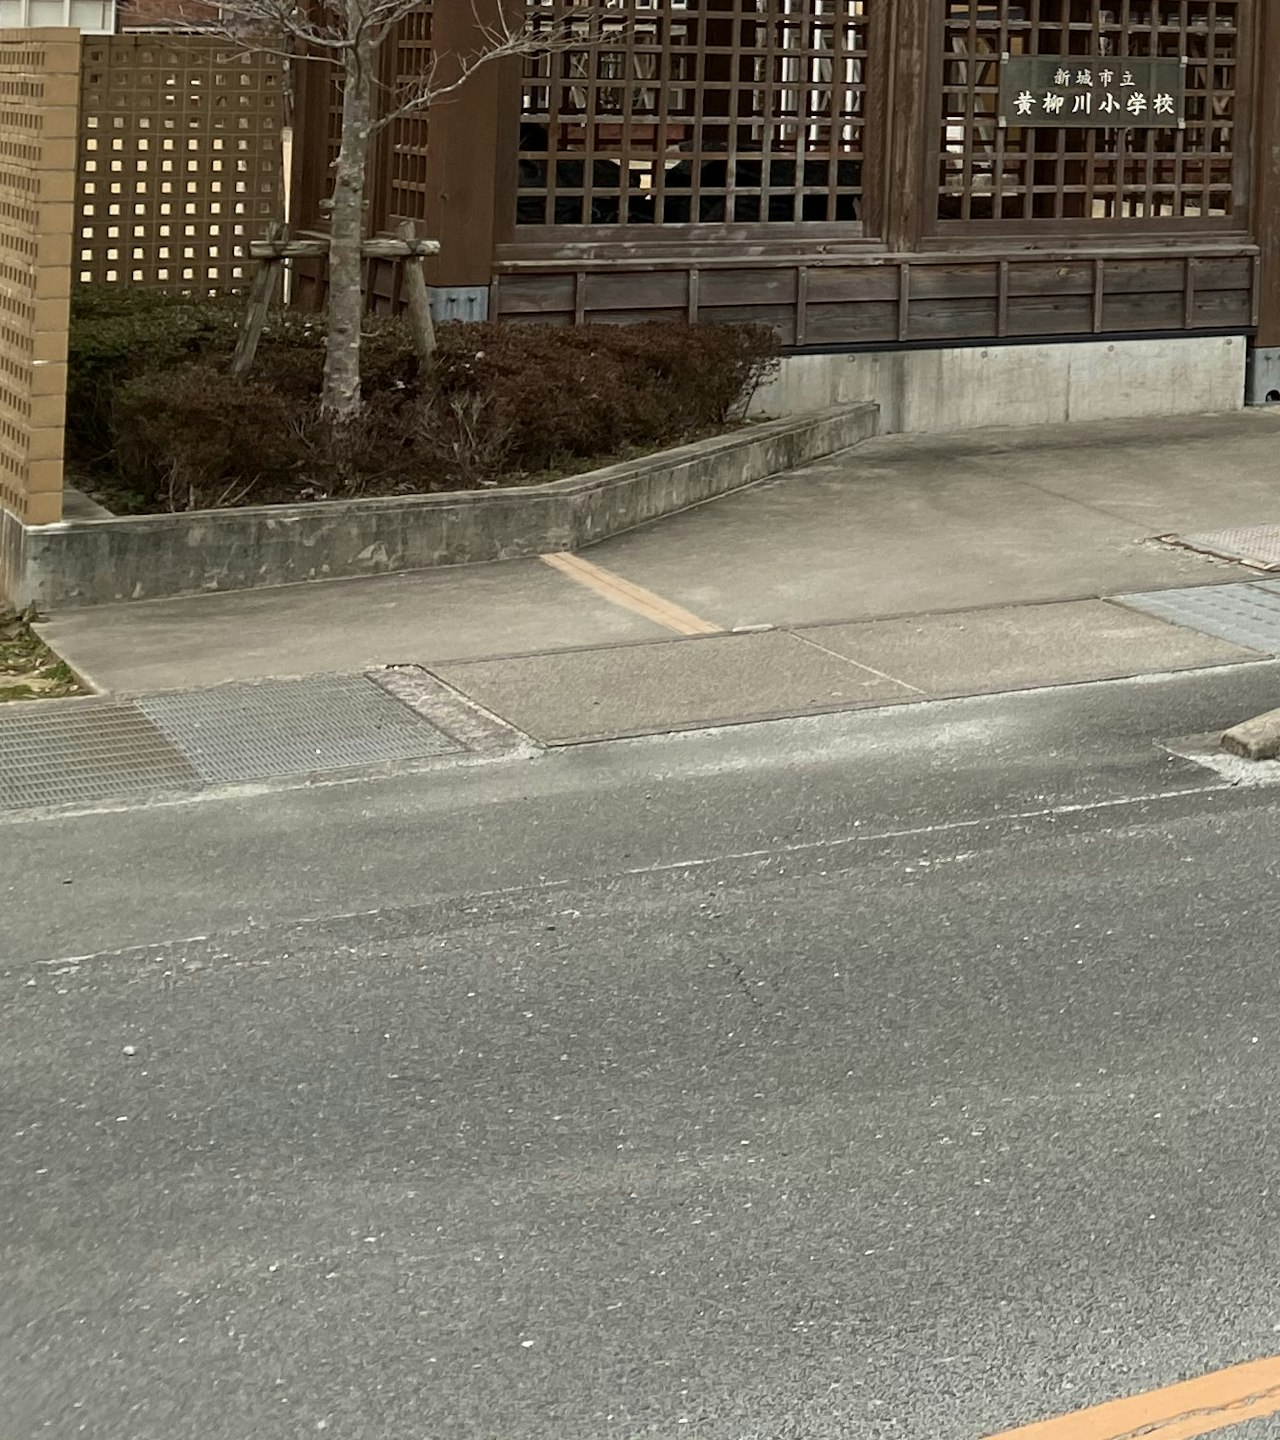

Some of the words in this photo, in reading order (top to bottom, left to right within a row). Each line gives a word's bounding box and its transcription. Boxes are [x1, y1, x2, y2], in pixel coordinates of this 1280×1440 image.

[1053, 68, 1136, 88] 新城市立
[1012, 91, 1175, 116] 黄柳川小学校
